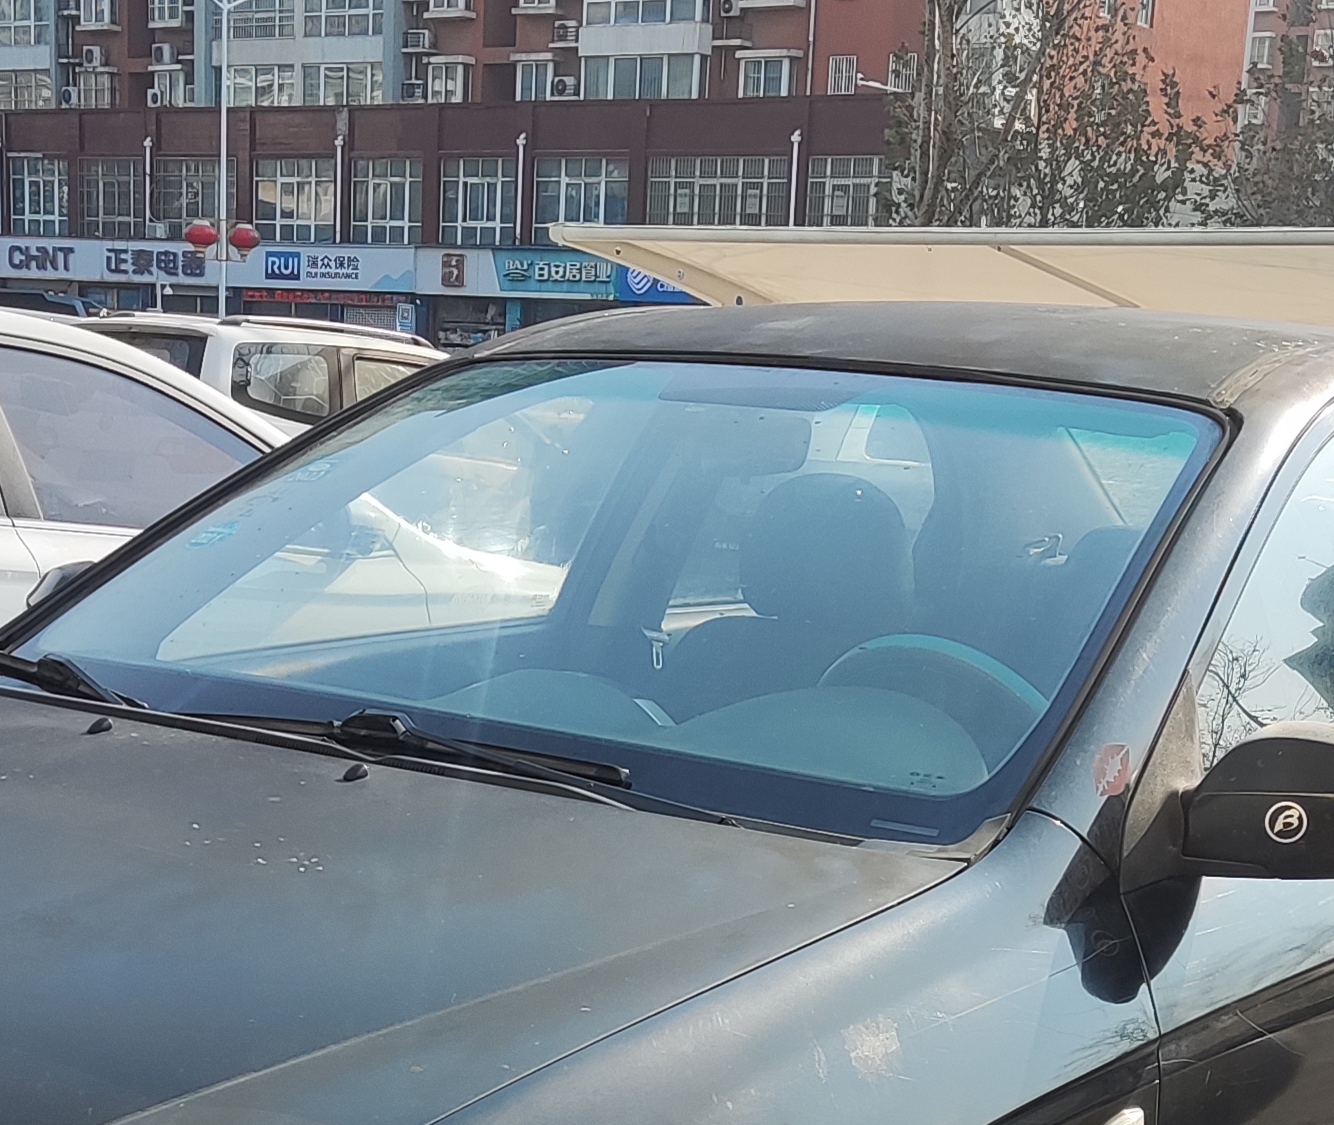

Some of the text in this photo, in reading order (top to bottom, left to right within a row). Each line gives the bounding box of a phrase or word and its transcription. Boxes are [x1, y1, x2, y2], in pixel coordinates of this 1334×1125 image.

[8, 245, 206, 278] CHNT 正泰电器
[267, 256, 299, 275] RUI
[306, 255, 360, 271] 瑞众保险
[534, 261, 612, 281] 百安居管业
[320, 272, 359, 280] INSURANCE
